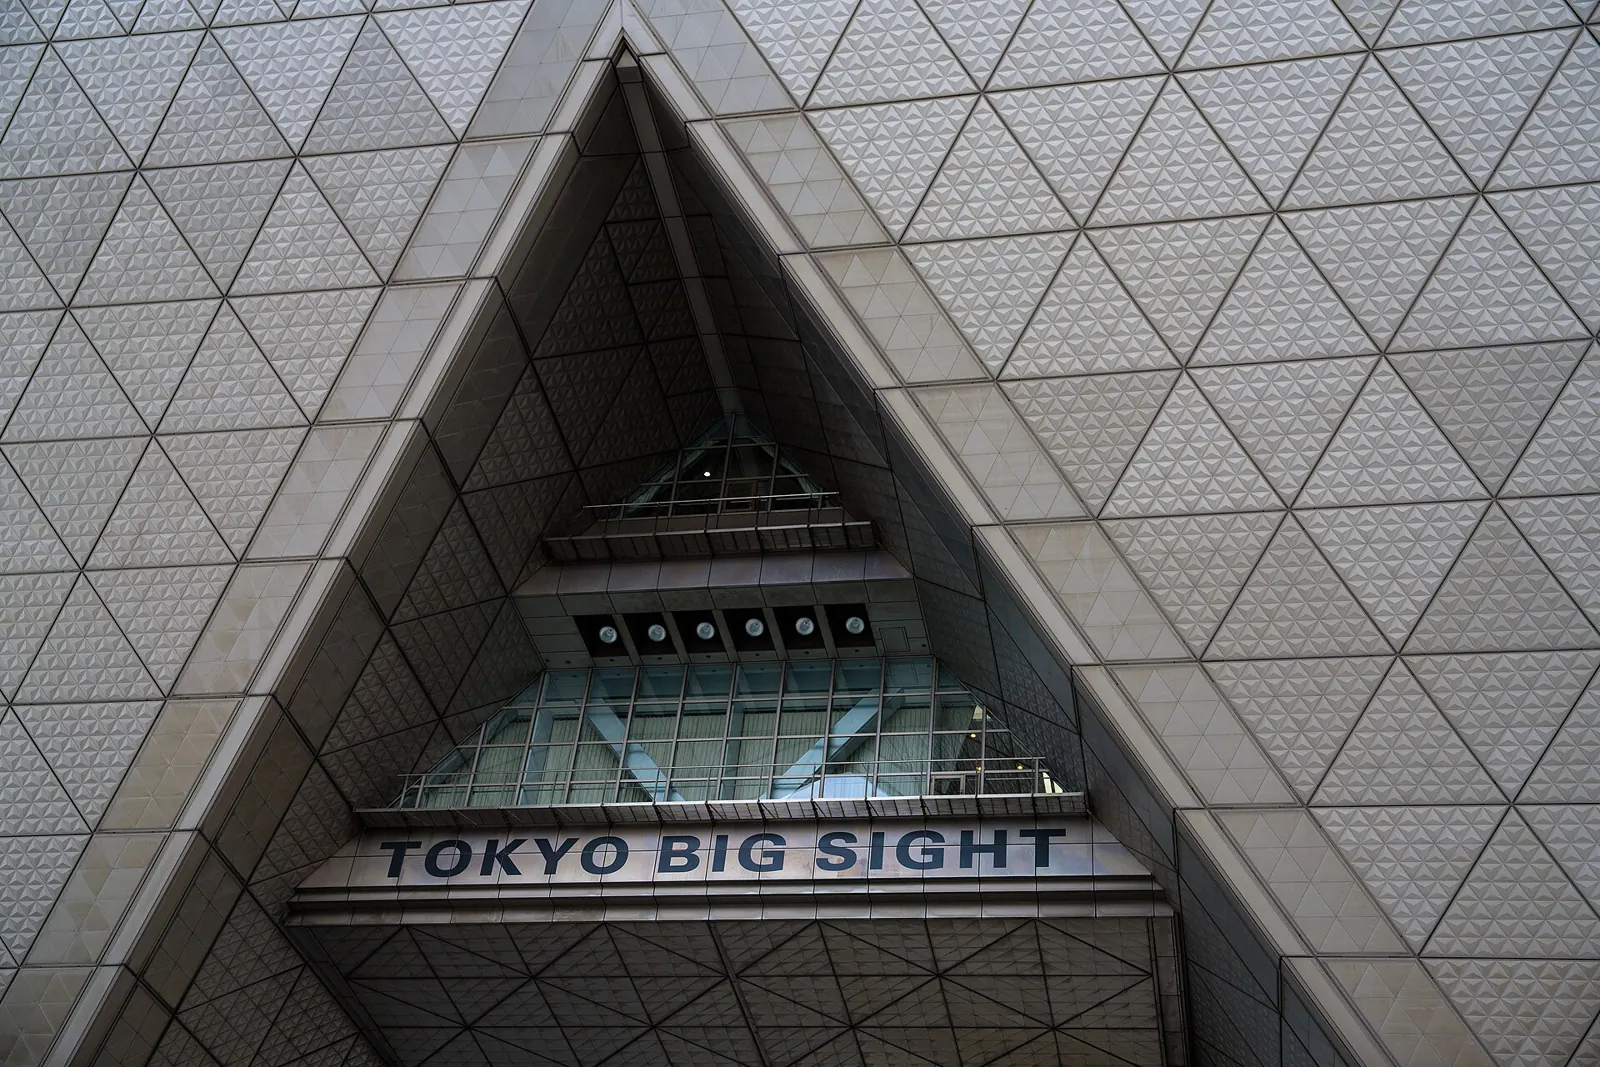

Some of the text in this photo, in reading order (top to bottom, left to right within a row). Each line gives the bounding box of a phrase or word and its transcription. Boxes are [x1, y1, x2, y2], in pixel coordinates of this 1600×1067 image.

[380, 829, 1066, 877] TOKYO BIG SIGHT
